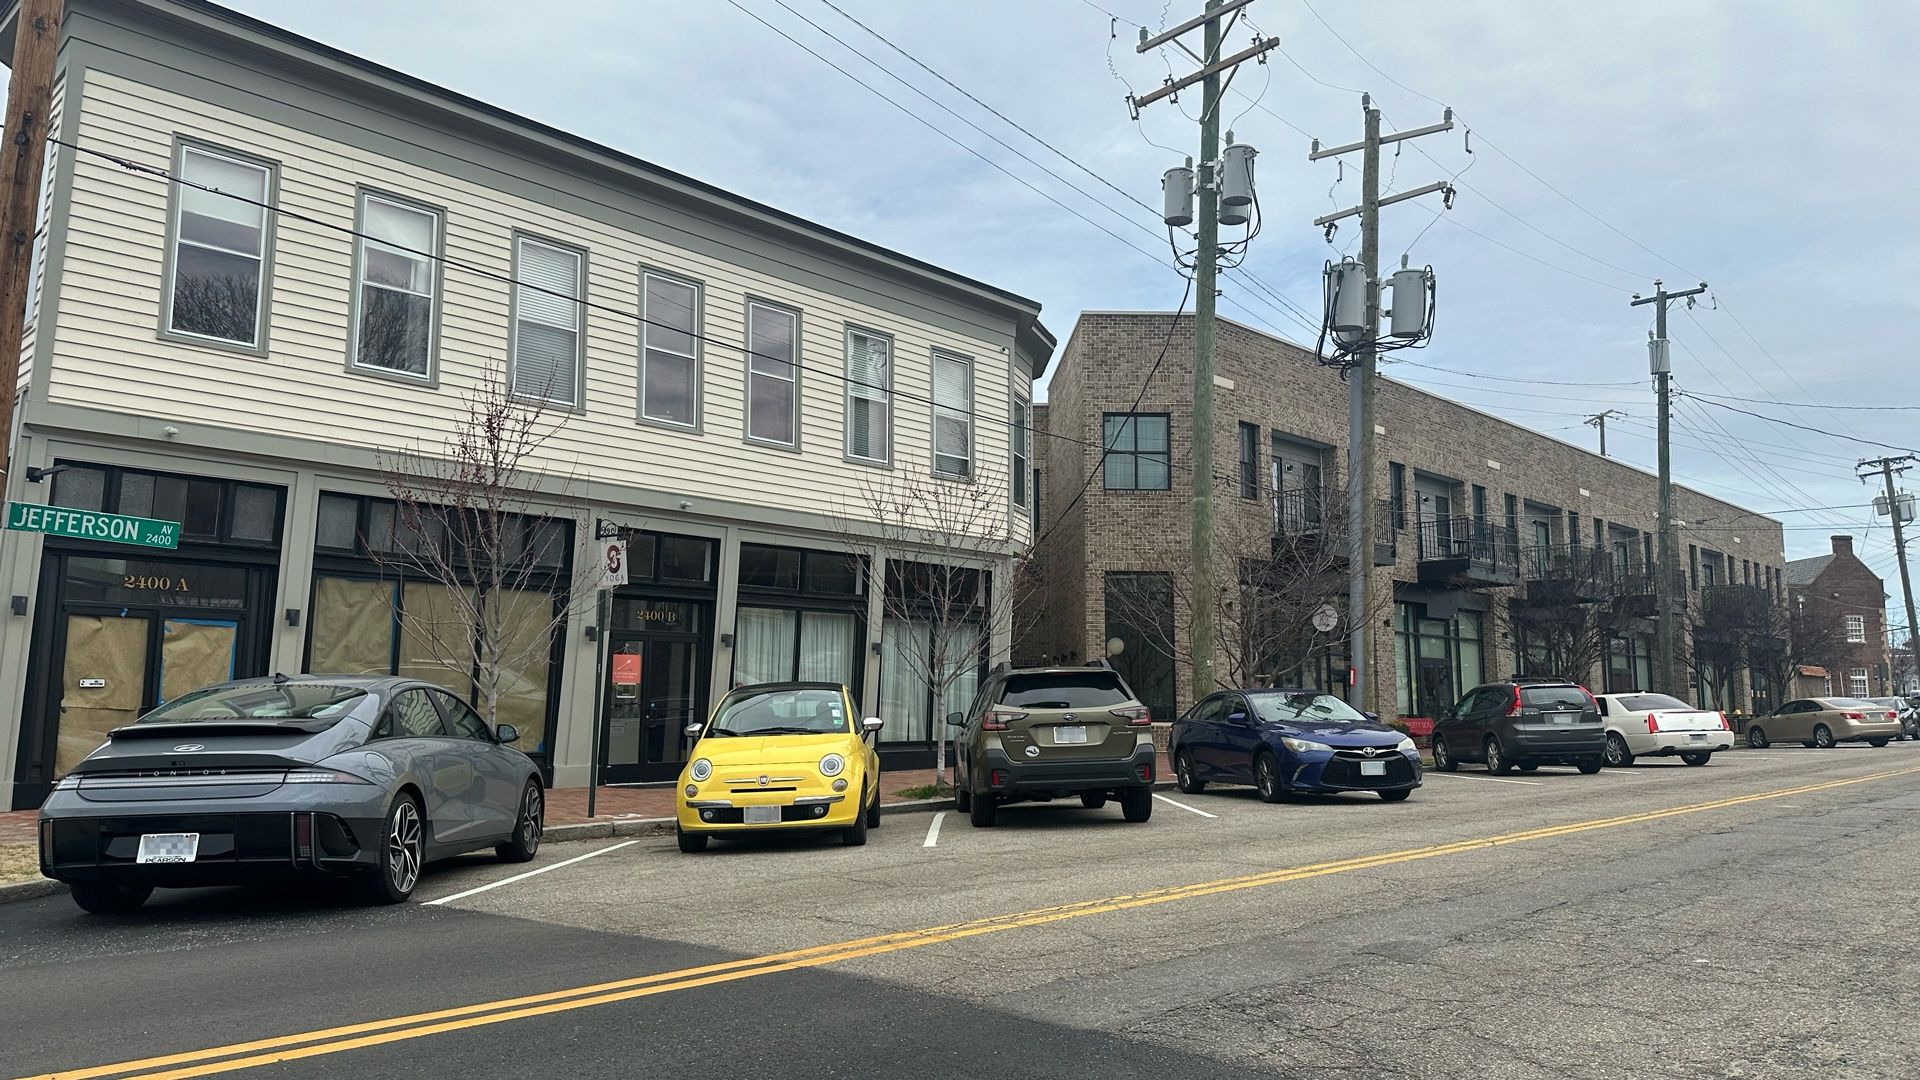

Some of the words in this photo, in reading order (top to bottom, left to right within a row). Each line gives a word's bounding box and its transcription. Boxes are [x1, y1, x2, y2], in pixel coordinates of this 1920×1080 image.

[13, 507, 139, 540] JEFFERSON
[161, 525, 173, 535] AV
[146, 534, 171, 545] 2400
[124, 575, 171, 590] 2400
[175, 578, 190, 591] A
[636, 610, 664, 621] 2400
[668, 611, 676, 622] B
